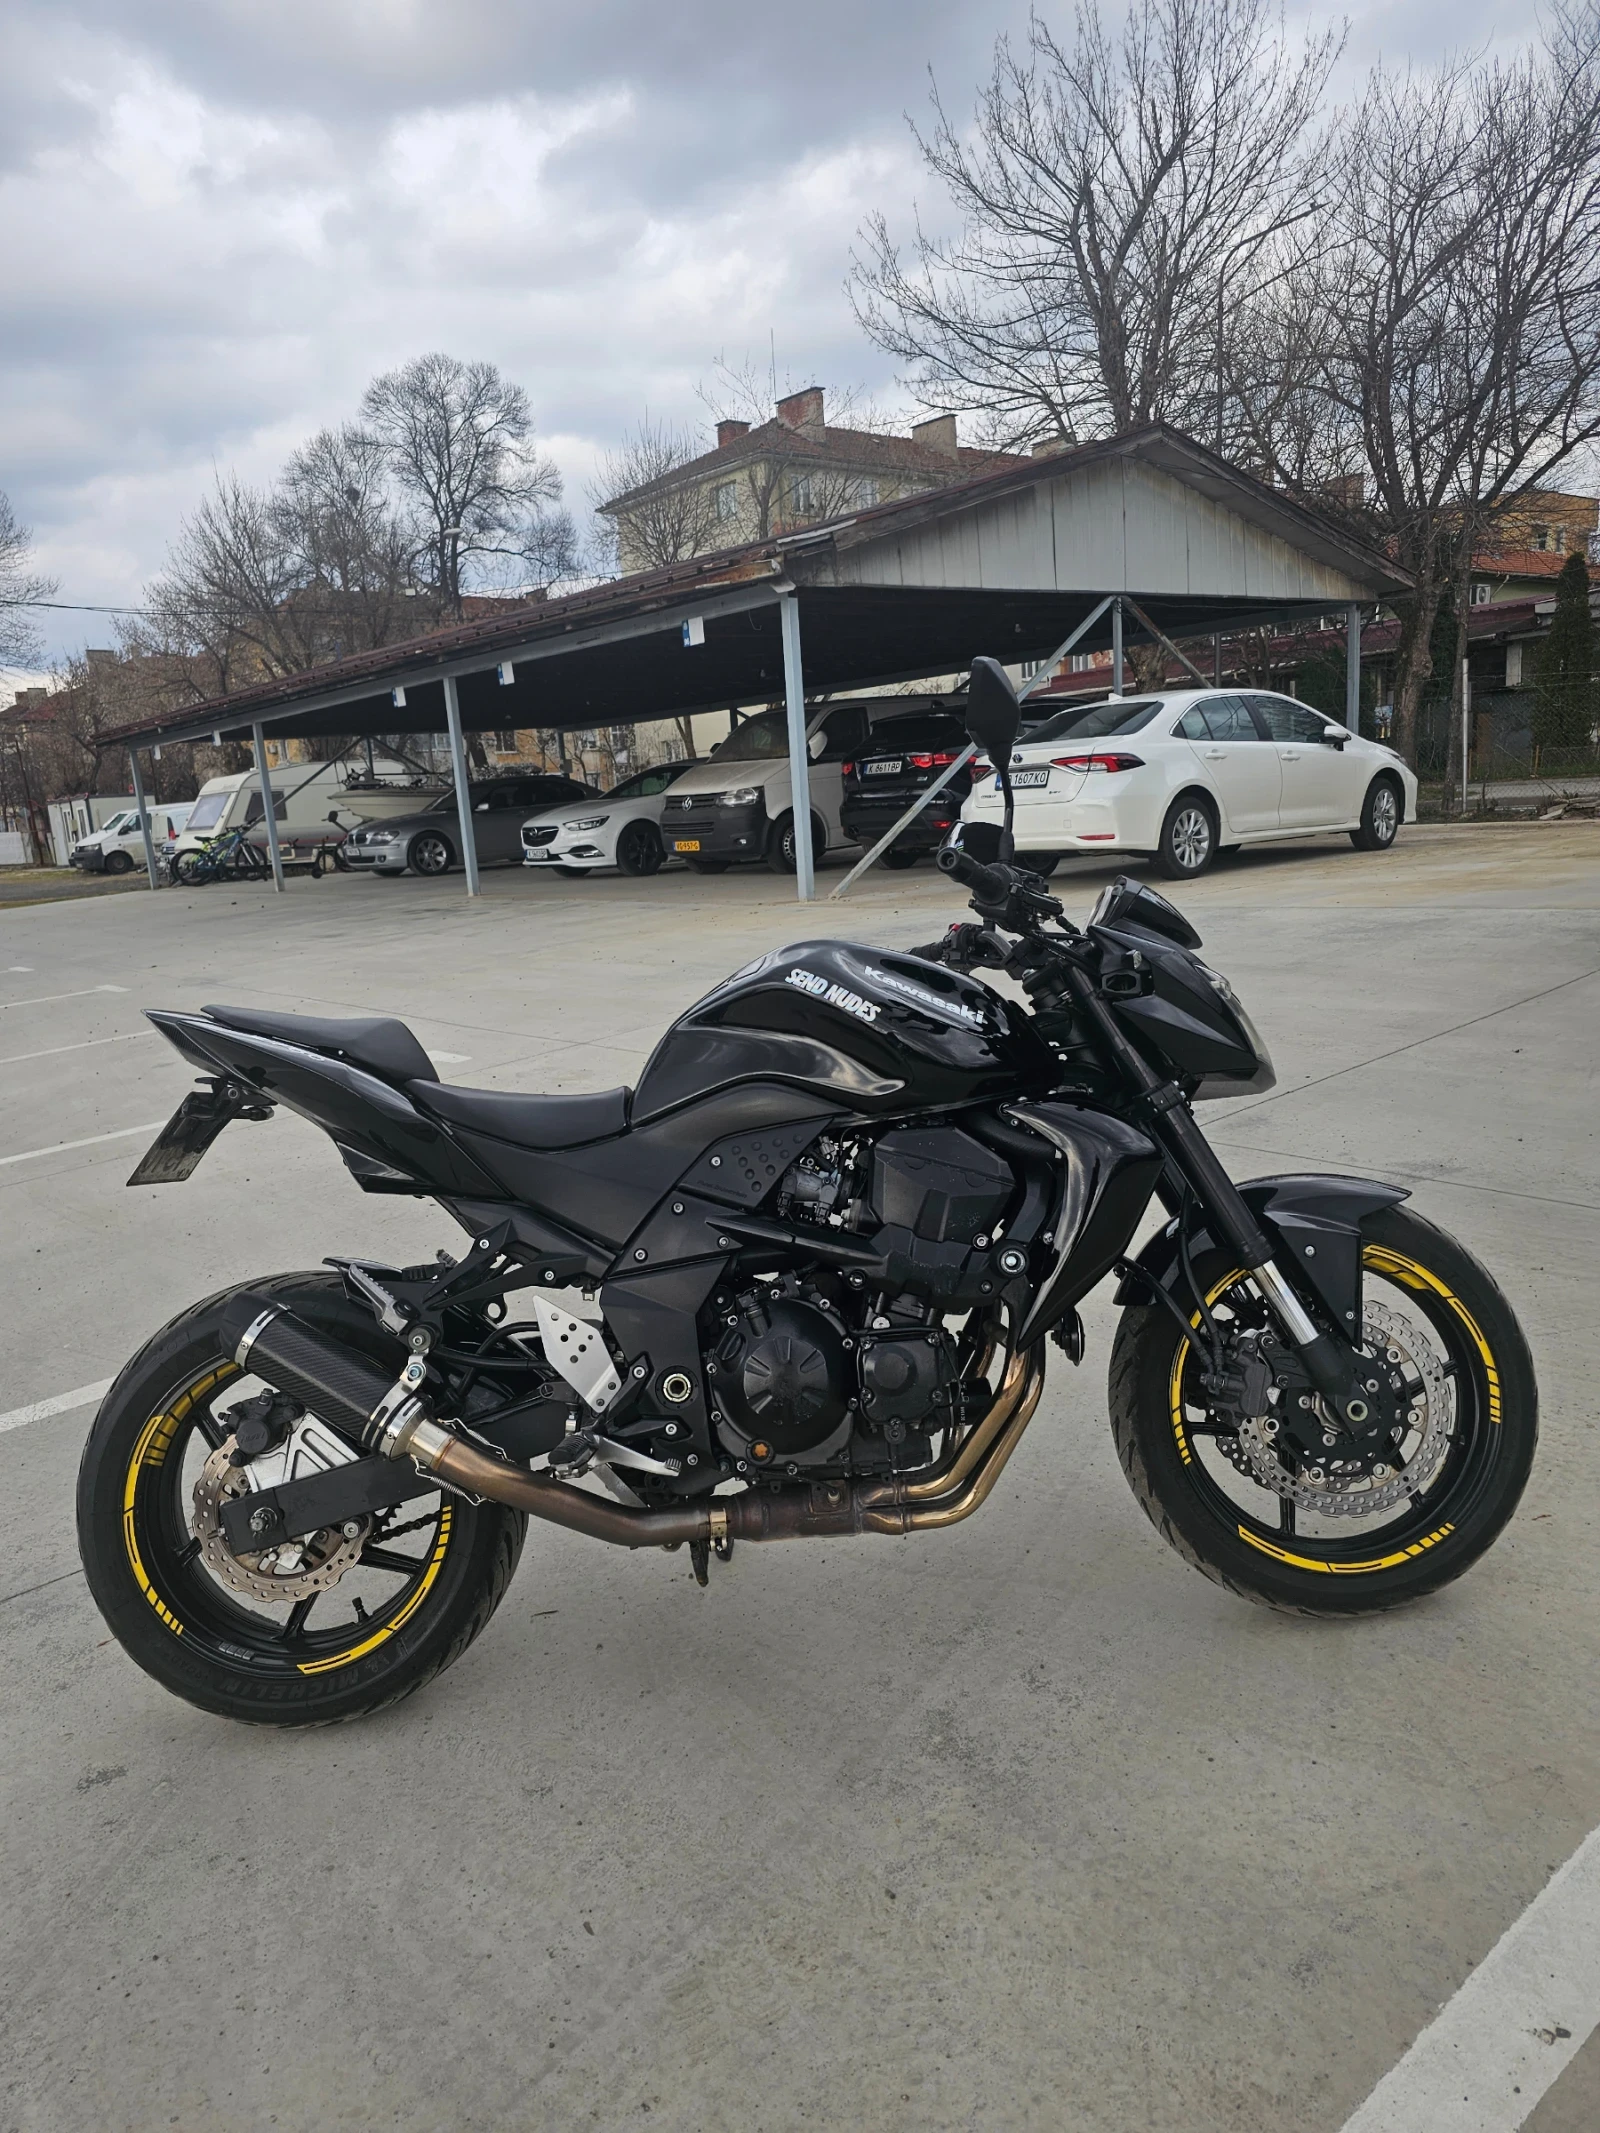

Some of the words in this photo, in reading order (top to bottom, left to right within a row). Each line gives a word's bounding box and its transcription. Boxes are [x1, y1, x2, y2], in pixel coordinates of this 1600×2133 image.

[785, 968, 828, 995] SEND
[824, 984, 881, 1022] NUDES
[864, 966, 985, 1024] Kawasaki
[218, 1672, 359, 1700] MICHELIN
